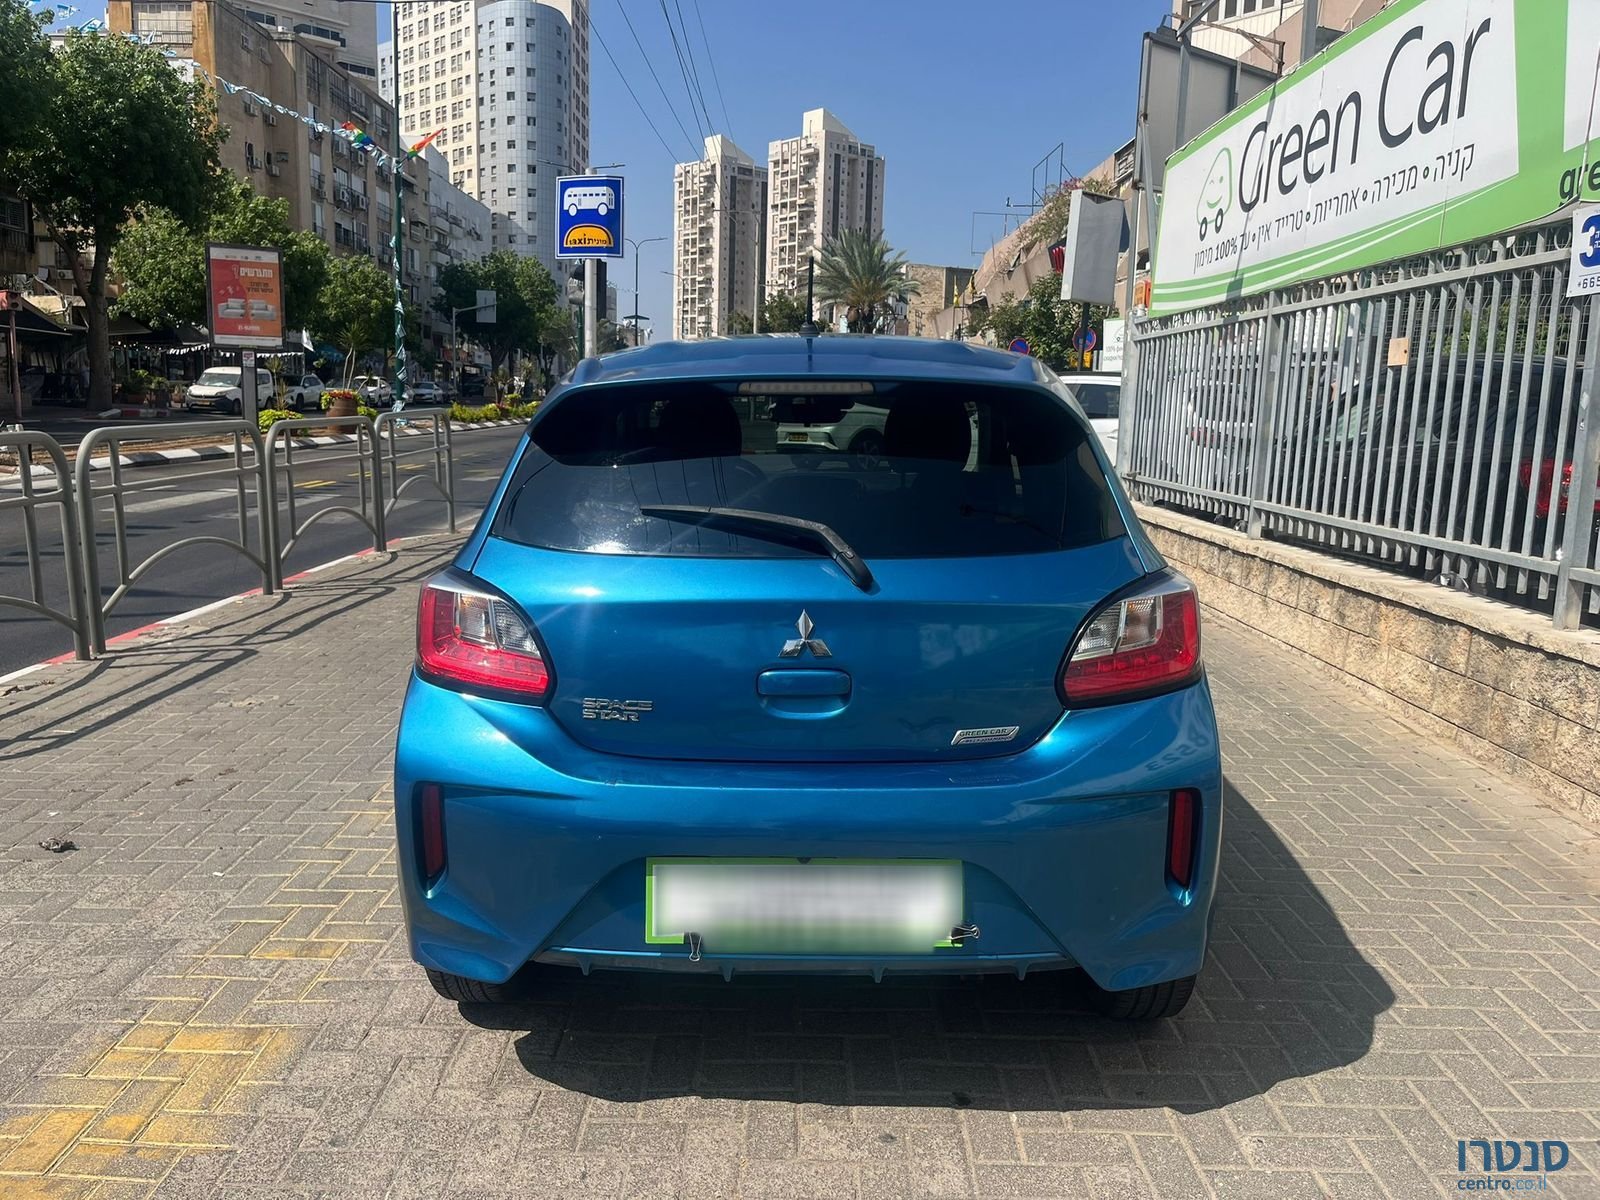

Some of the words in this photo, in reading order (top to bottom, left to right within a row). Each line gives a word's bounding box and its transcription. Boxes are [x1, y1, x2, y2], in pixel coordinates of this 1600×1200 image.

[1238, 90, 1362, 213] Green
[1378, 17, 1491, 148] Car
[1433, 143, 1475, 182] קניה
[1371, 165, 1418, 204] מכירה
[1312, 187, 1360, 225] אחריות
[1256, 222, 1272, 251] אין
[1275, 209, 1304, 238] טרייד
[569, 233, 587, 246] taxi
[587, 238, 608, 246] מונית
[1215, 236, 1238, 262] 100%
[1193, 247, 1213, 275] מימון
[582, 697, 653, 710] SPACE
[582, 708, 640, 722] STAR
